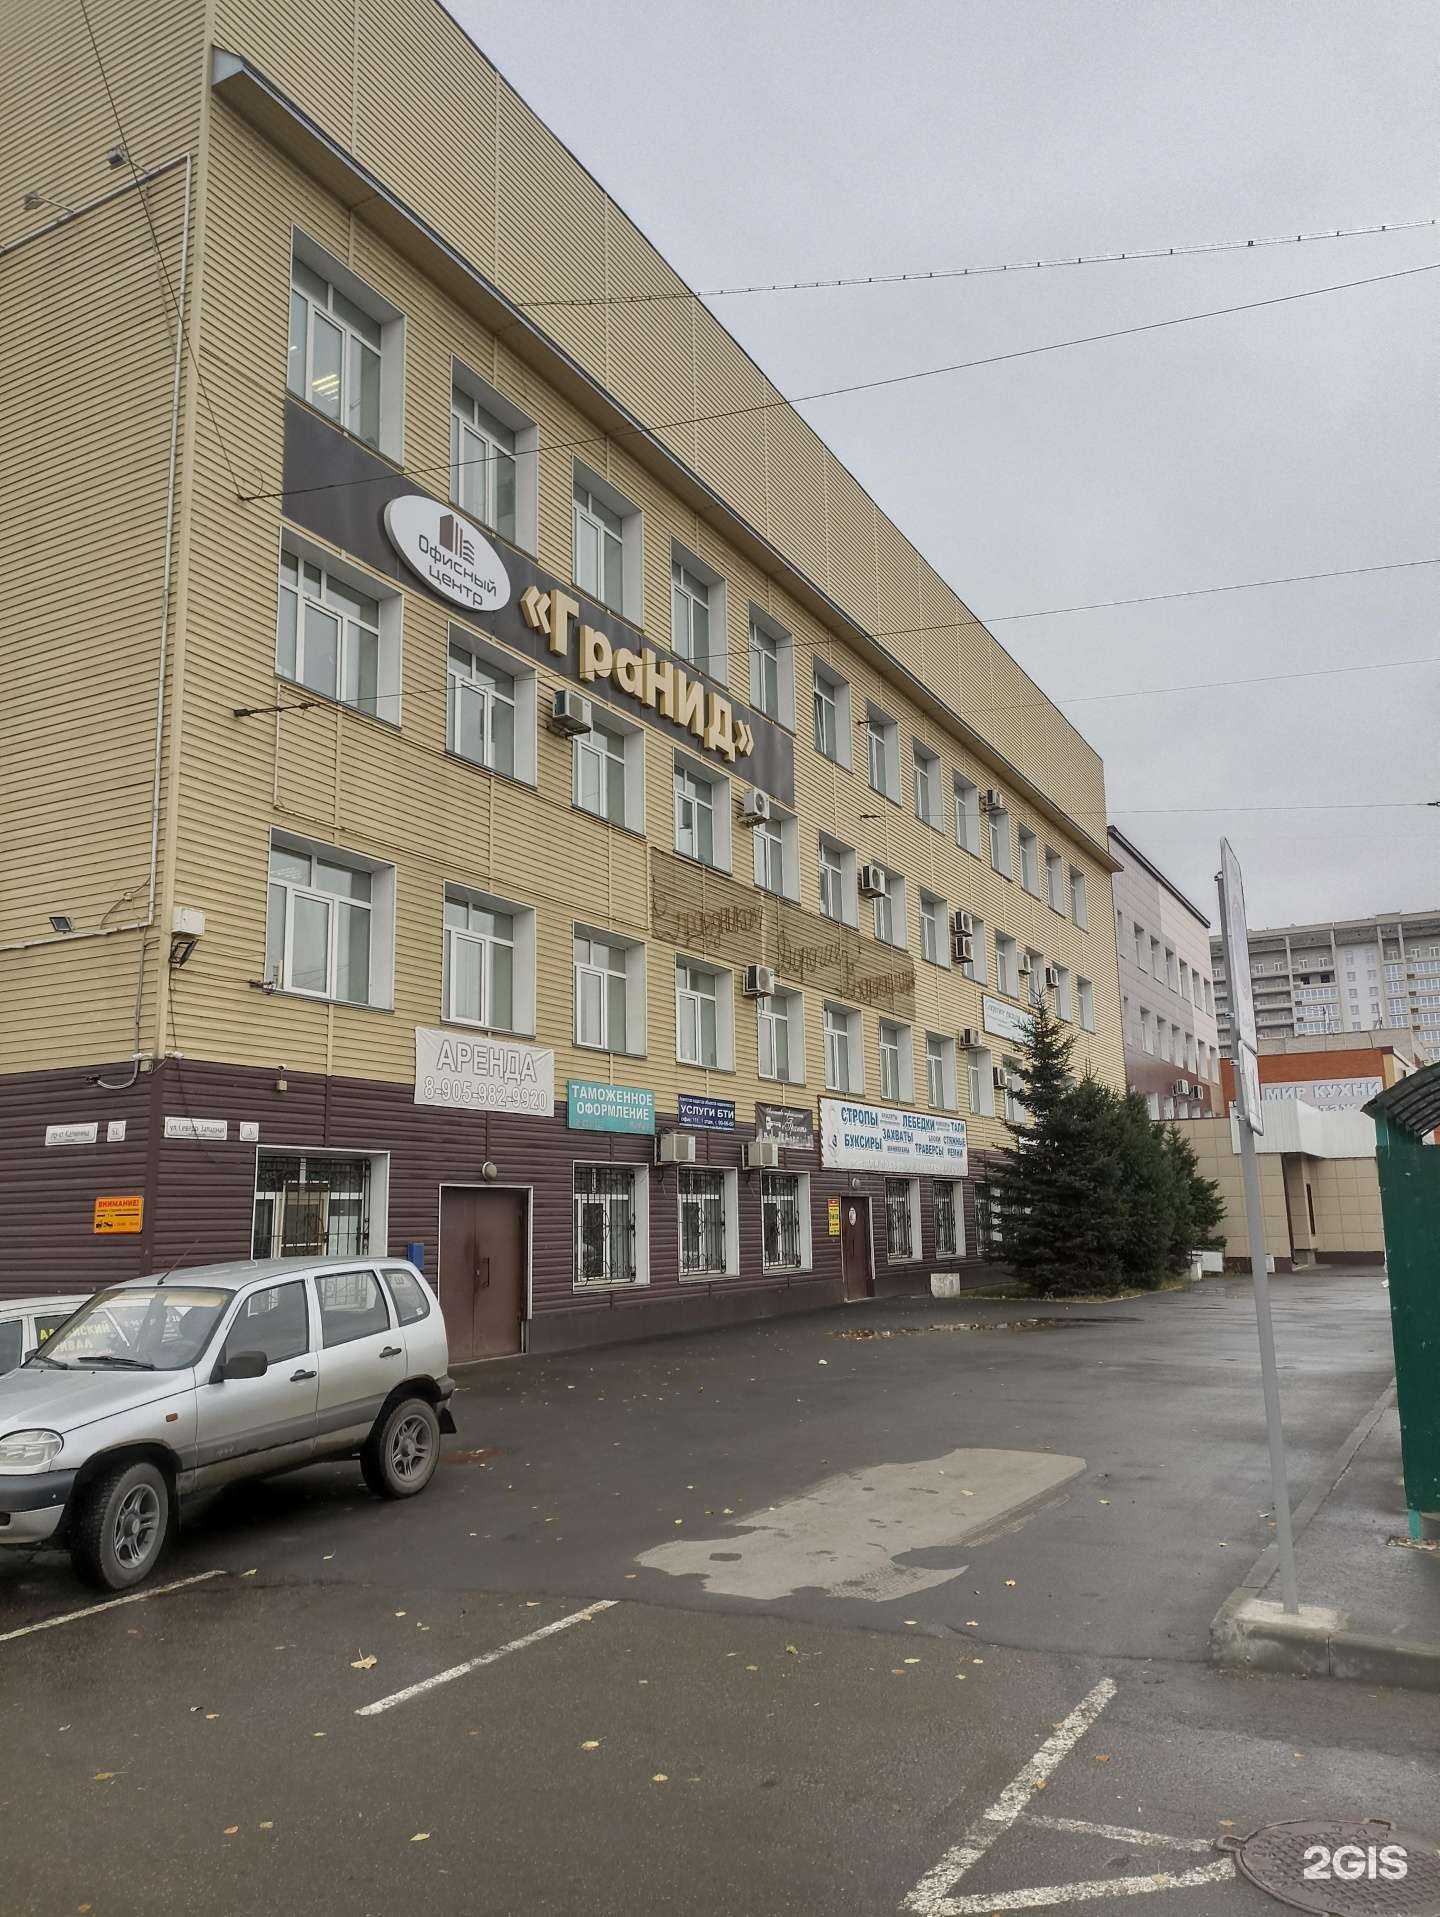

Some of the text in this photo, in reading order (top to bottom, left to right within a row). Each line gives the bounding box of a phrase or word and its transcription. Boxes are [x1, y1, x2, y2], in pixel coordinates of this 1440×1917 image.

[419, 534, 497, 597] Офисный
[429, 565, 483, 606] центр
[436, 1039, 537, 1086] АРЕНДА
[424, 1076, 547, 1111] 8-905-982-9920
[571, 1084, 653, 1106] ТАМОЖЕННОЕ
[1264, 1081, 1380, 1101] МИР КУХНИ
[576, 1102, 649, 1120] ОФОРМЛЕНИЕ
[680, 1104, 734, 1119] УСЛУГИ БТИ
[841, 1106, 878, 1126] СТРОПЫ
[902, 1114, 936, 1132] ЛЕБЕДКИ
[844, 1133, 882, 1150] БУКСИРЫ
[914, 1143, 945, 1156] ТРАВЕРСЫ
[881, 1128, 914, 1142] ЗАХВАТЫ
